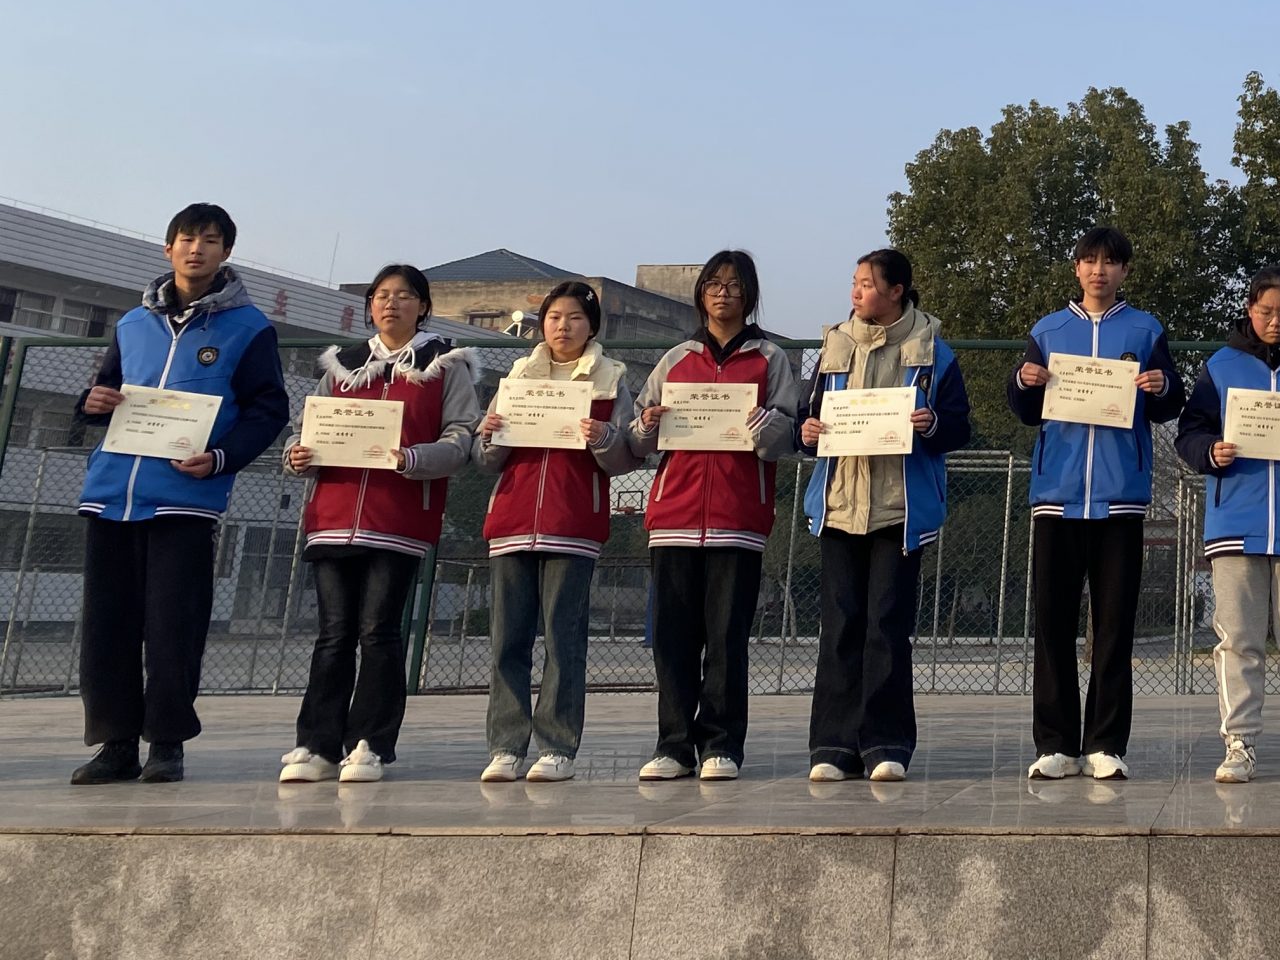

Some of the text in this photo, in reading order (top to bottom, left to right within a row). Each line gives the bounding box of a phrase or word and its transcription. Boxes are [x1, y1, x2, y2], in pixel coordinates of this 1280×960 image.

[1074, 365, 1113, 377] 荣誉证书
[525, 389, 566, 398] 荣誉证书
[689, 393, 730, 401] 荣誉证书
[333, 408, 375, 417] 荣誉证书
